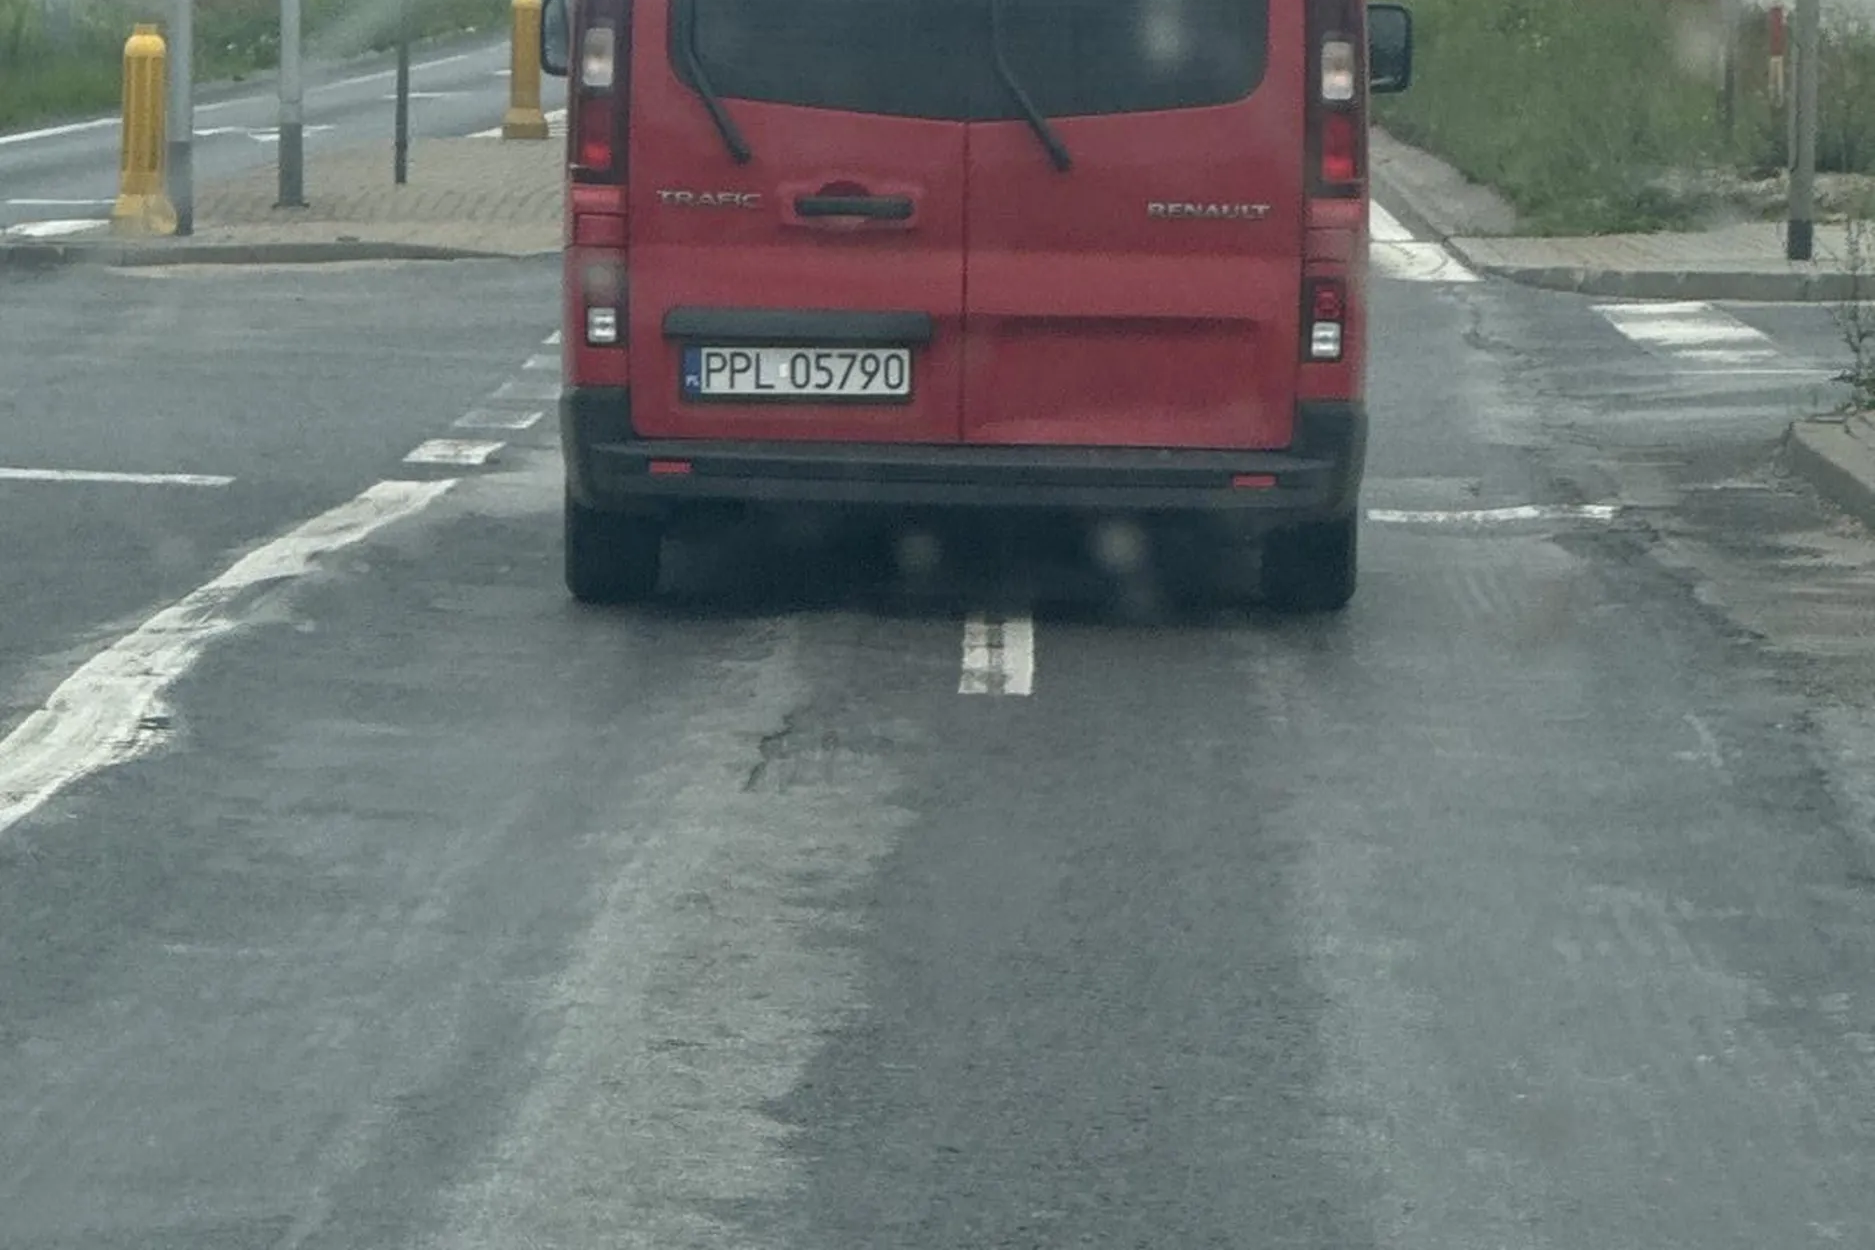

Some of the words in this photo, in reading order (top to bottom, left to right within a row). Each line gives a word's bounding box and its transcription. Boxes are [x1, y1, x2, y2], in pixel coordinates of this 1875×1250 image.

[656, 189, 762, 208] TRAFIC
[1147, 202, 1271, 219] RENAULT
[705, 352, 775, 390] PPL
[790, 353, 904, 390] 05790
